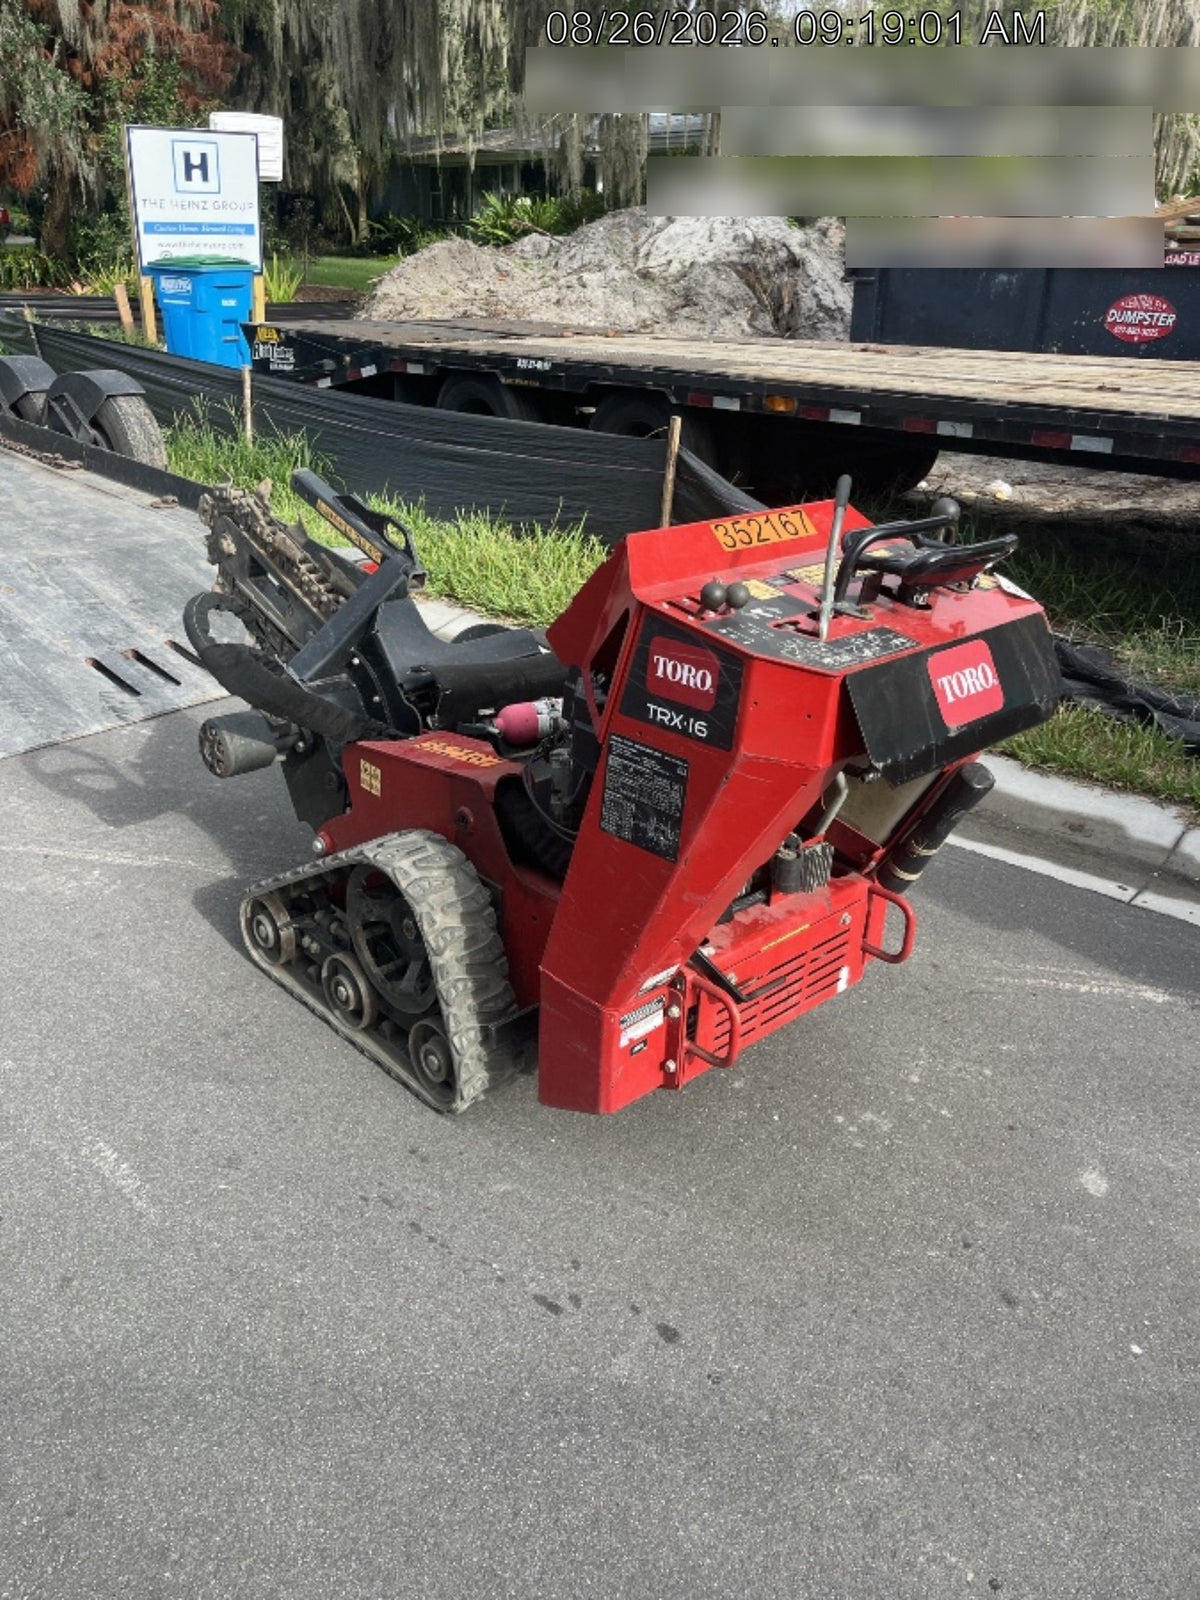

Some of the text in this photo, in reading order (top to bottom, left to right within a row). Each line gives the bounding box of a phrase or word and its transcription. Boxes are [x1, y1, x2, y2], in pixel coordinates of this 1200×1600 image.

[182, 151, 209, 182] H
[142, 198, 255, 212] THE HEINZ GROUP
[1107, 308, 1176, 327] DUMPSTER
[714, 509, 809, 548] 352167
[653, 655, 713, 692] TORO
[937, 662, 995, 704] TORO
